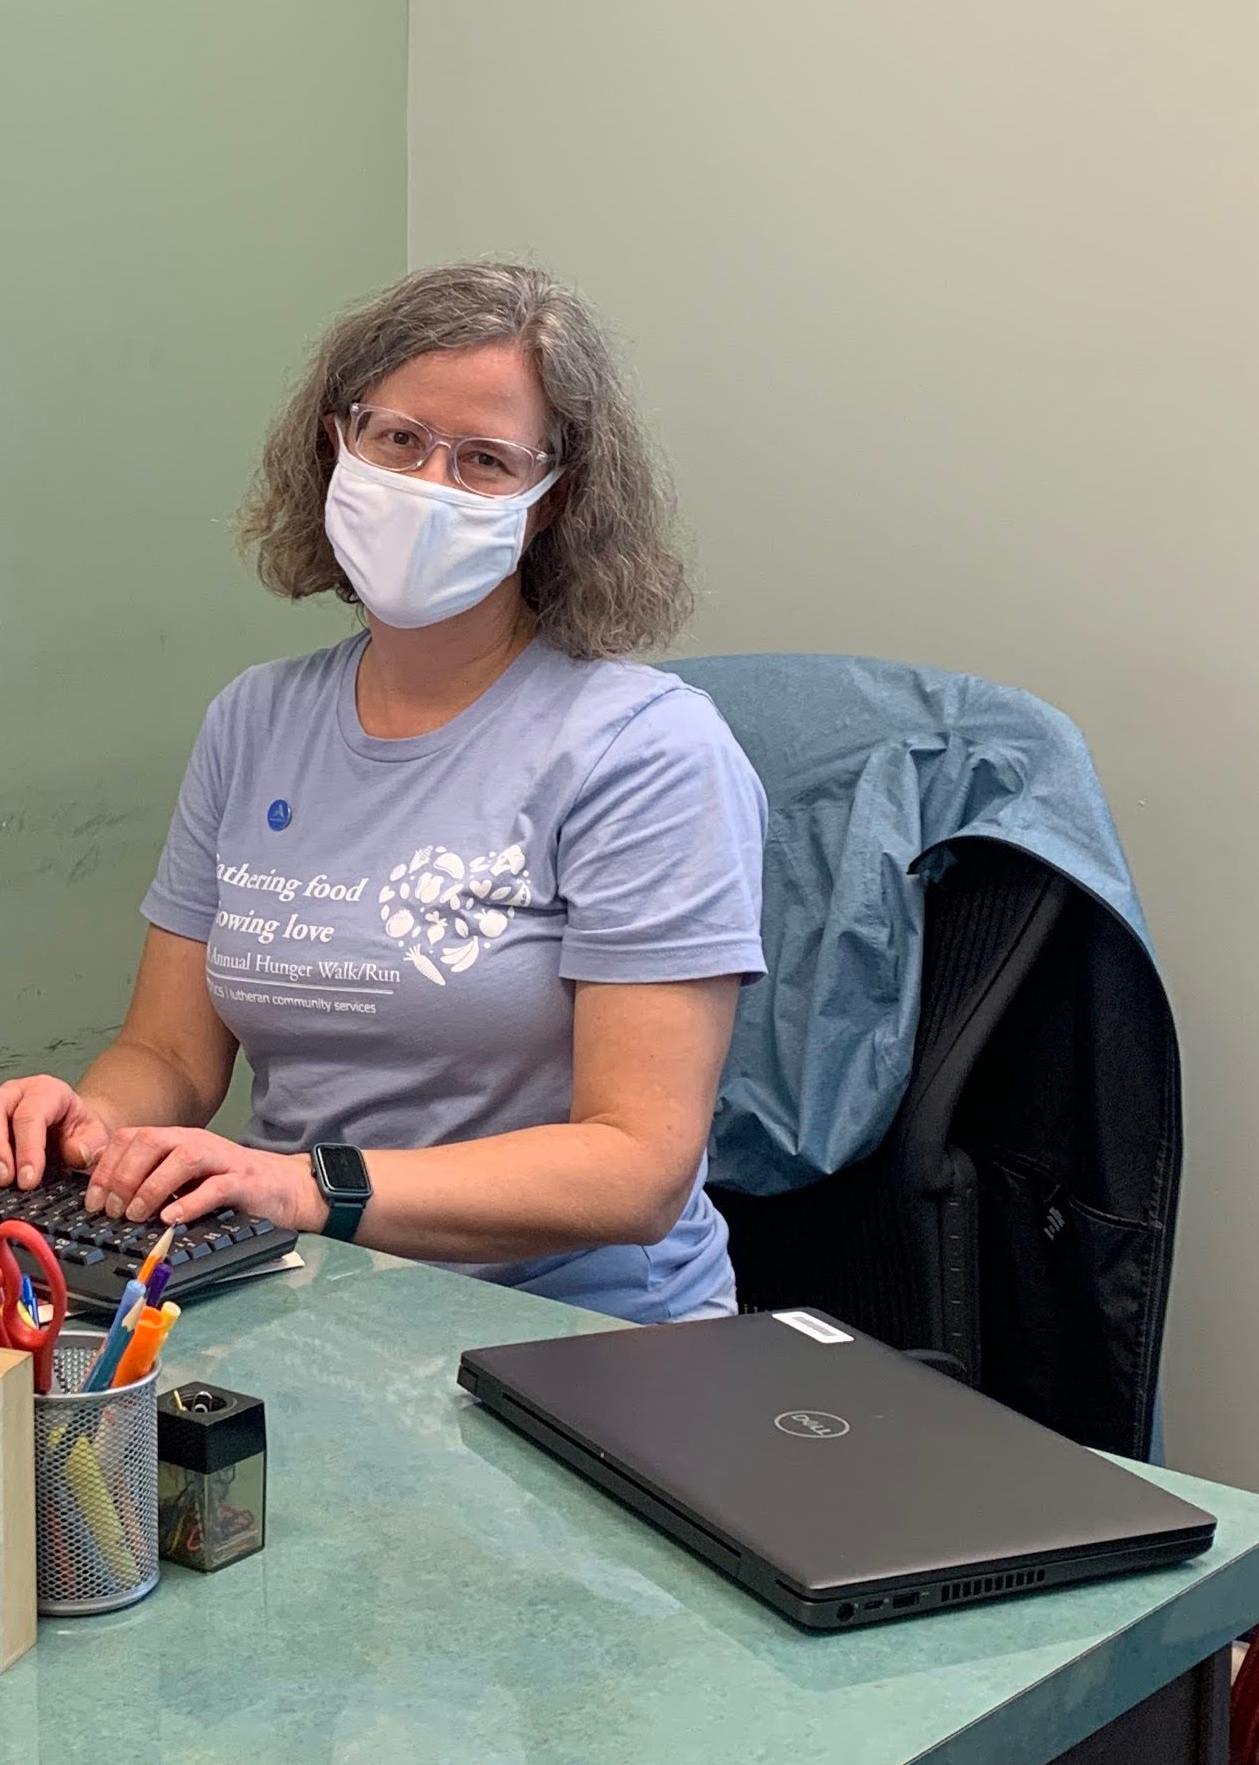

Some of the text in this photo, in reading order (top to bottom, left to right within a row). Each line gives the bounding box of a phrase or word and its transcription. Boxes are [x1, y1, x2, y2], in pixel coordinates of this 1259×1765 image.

[216, 855, 370, 902] athering food
[282, 914, 335, 943] love
[255, 953, 314, 981] Hunger
[318, 961, 402, 983] Walk/Run
[230, 987, 271, 1004] lutheran
[271, 995, 332, 1012] community
[334, 1000, 377, 1014] services
[791, 1414, 832, 1436] DELL
